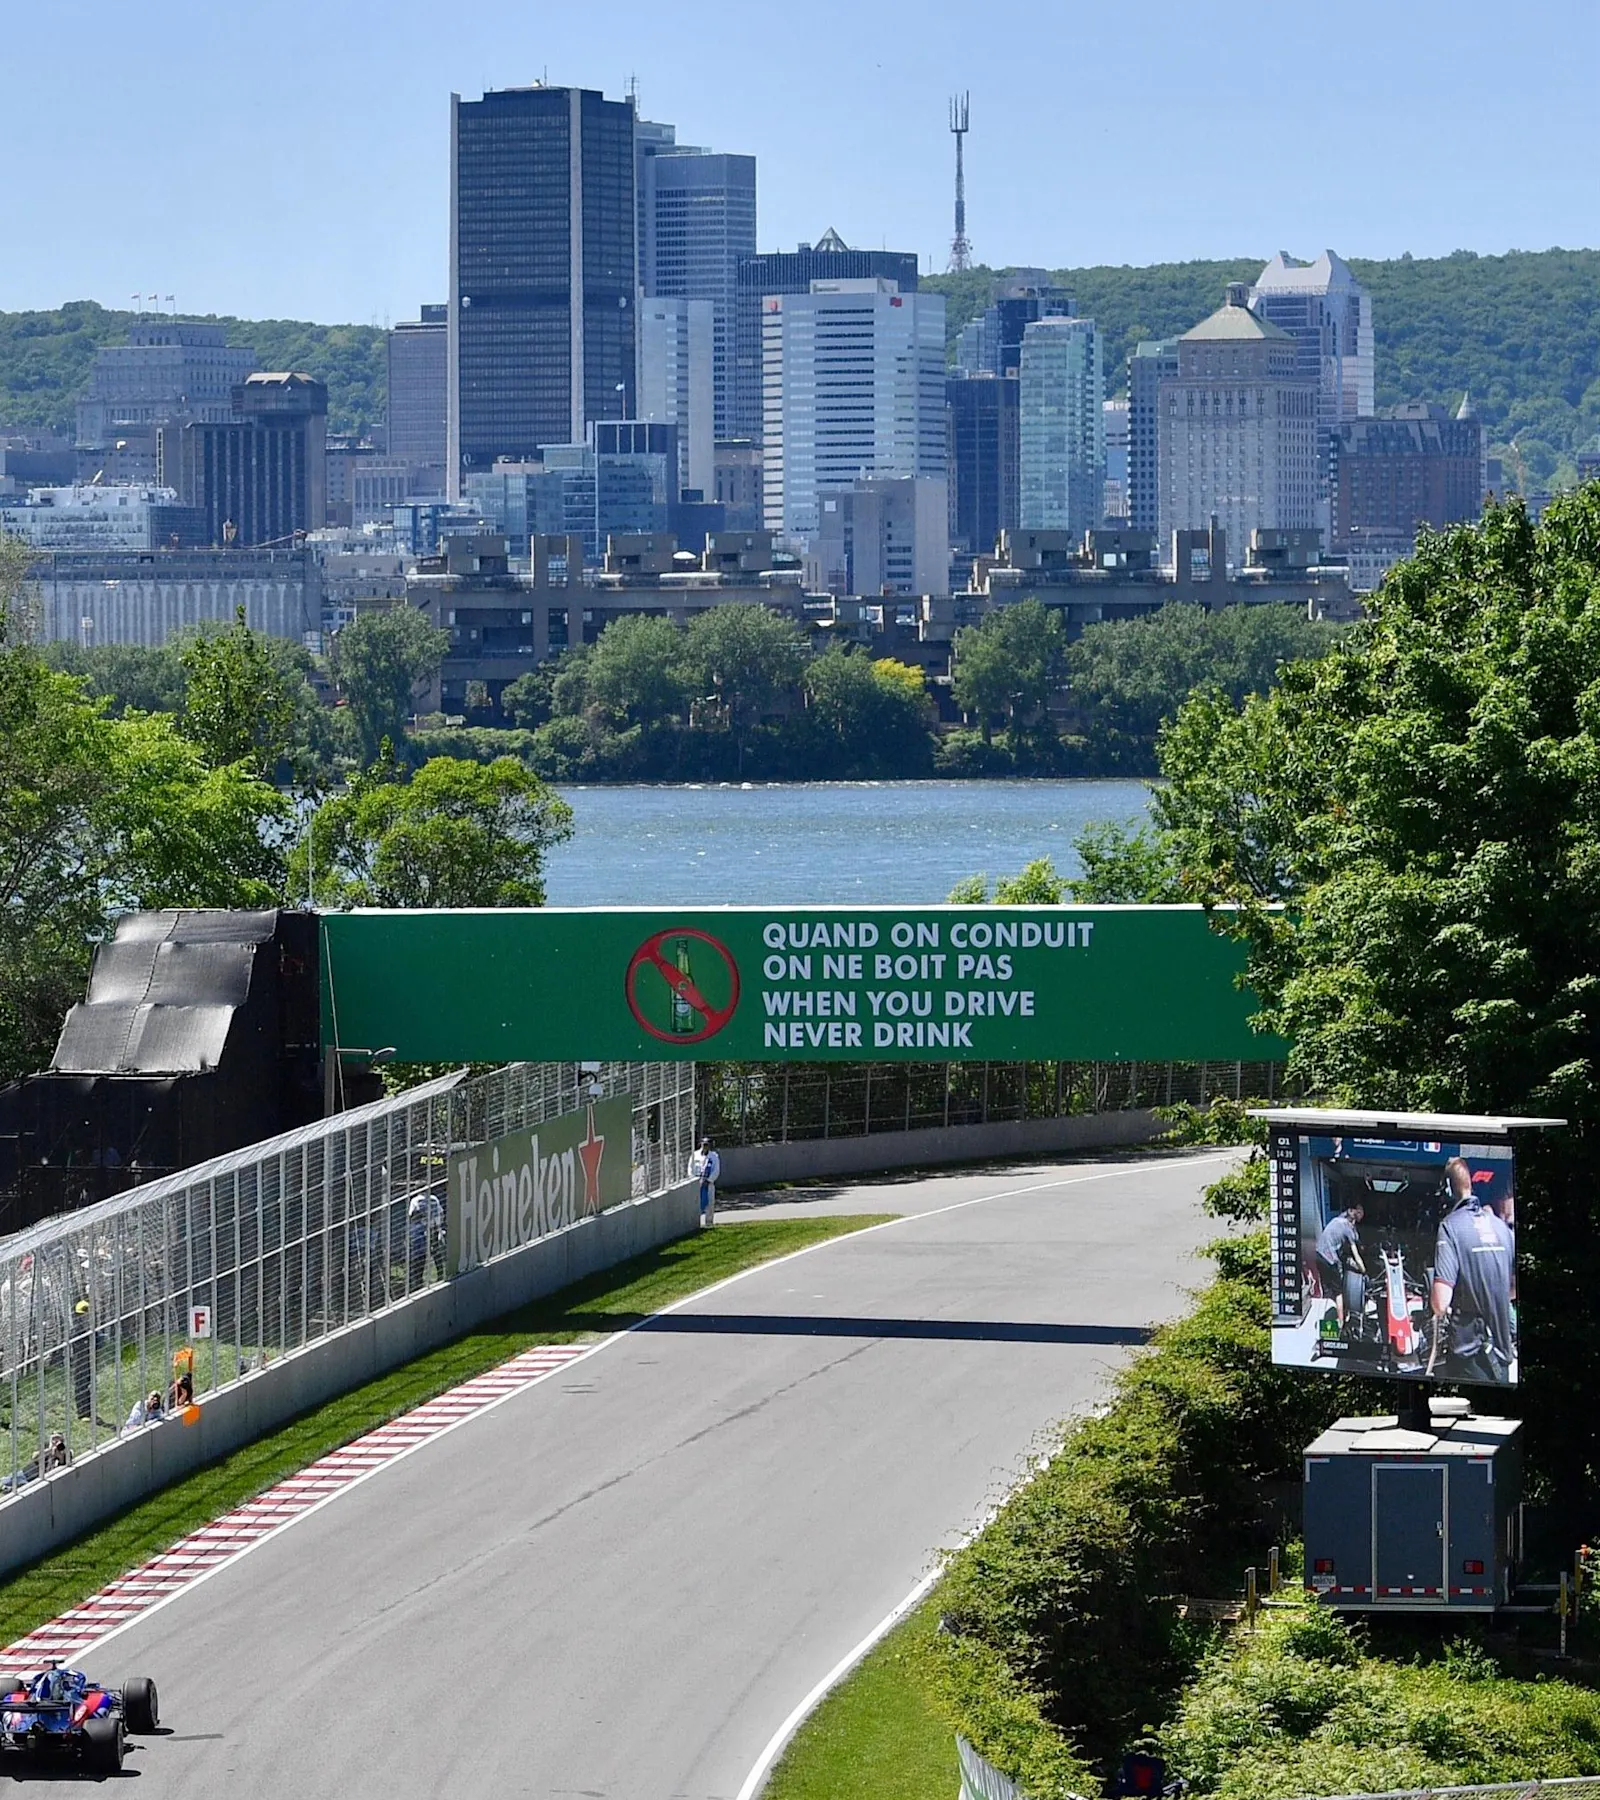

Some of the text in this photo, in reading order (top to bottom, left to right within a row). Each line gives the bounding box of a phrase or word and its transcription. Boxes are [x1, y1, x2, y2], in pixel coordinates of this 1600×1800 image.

[763, 922, 1095, 949] QUAND ON CONDUIT
[763, 954, 1013, 980] ON NE BOIT PAS
[762, 991, 1035, 1016] WHEN YOU DRIVE
[764, 1022, 973, 1047] NEVER DRINK
[1282, 1162, 1297, 1171] MAG
[1282, 1175, 1294, 1183] LEC
[458, 1133, 576, 1273] Heineken
[1283, 1213, 1296, 1223] VET
[1283, 1226, 1297, 1235] HAR
[1283, 1239, 1297, 1249] GAS
[1284, 1252, 1296, 1262] STR
[1284, 1266, 1296, 1275] VER
[1284, 1278, 1296, 1288] RAI
[1285, 1292, 1300, 1301] HAM
[1285, 1304, 1295, 1313] RIC
[194, 1312, 206, 1333] F
